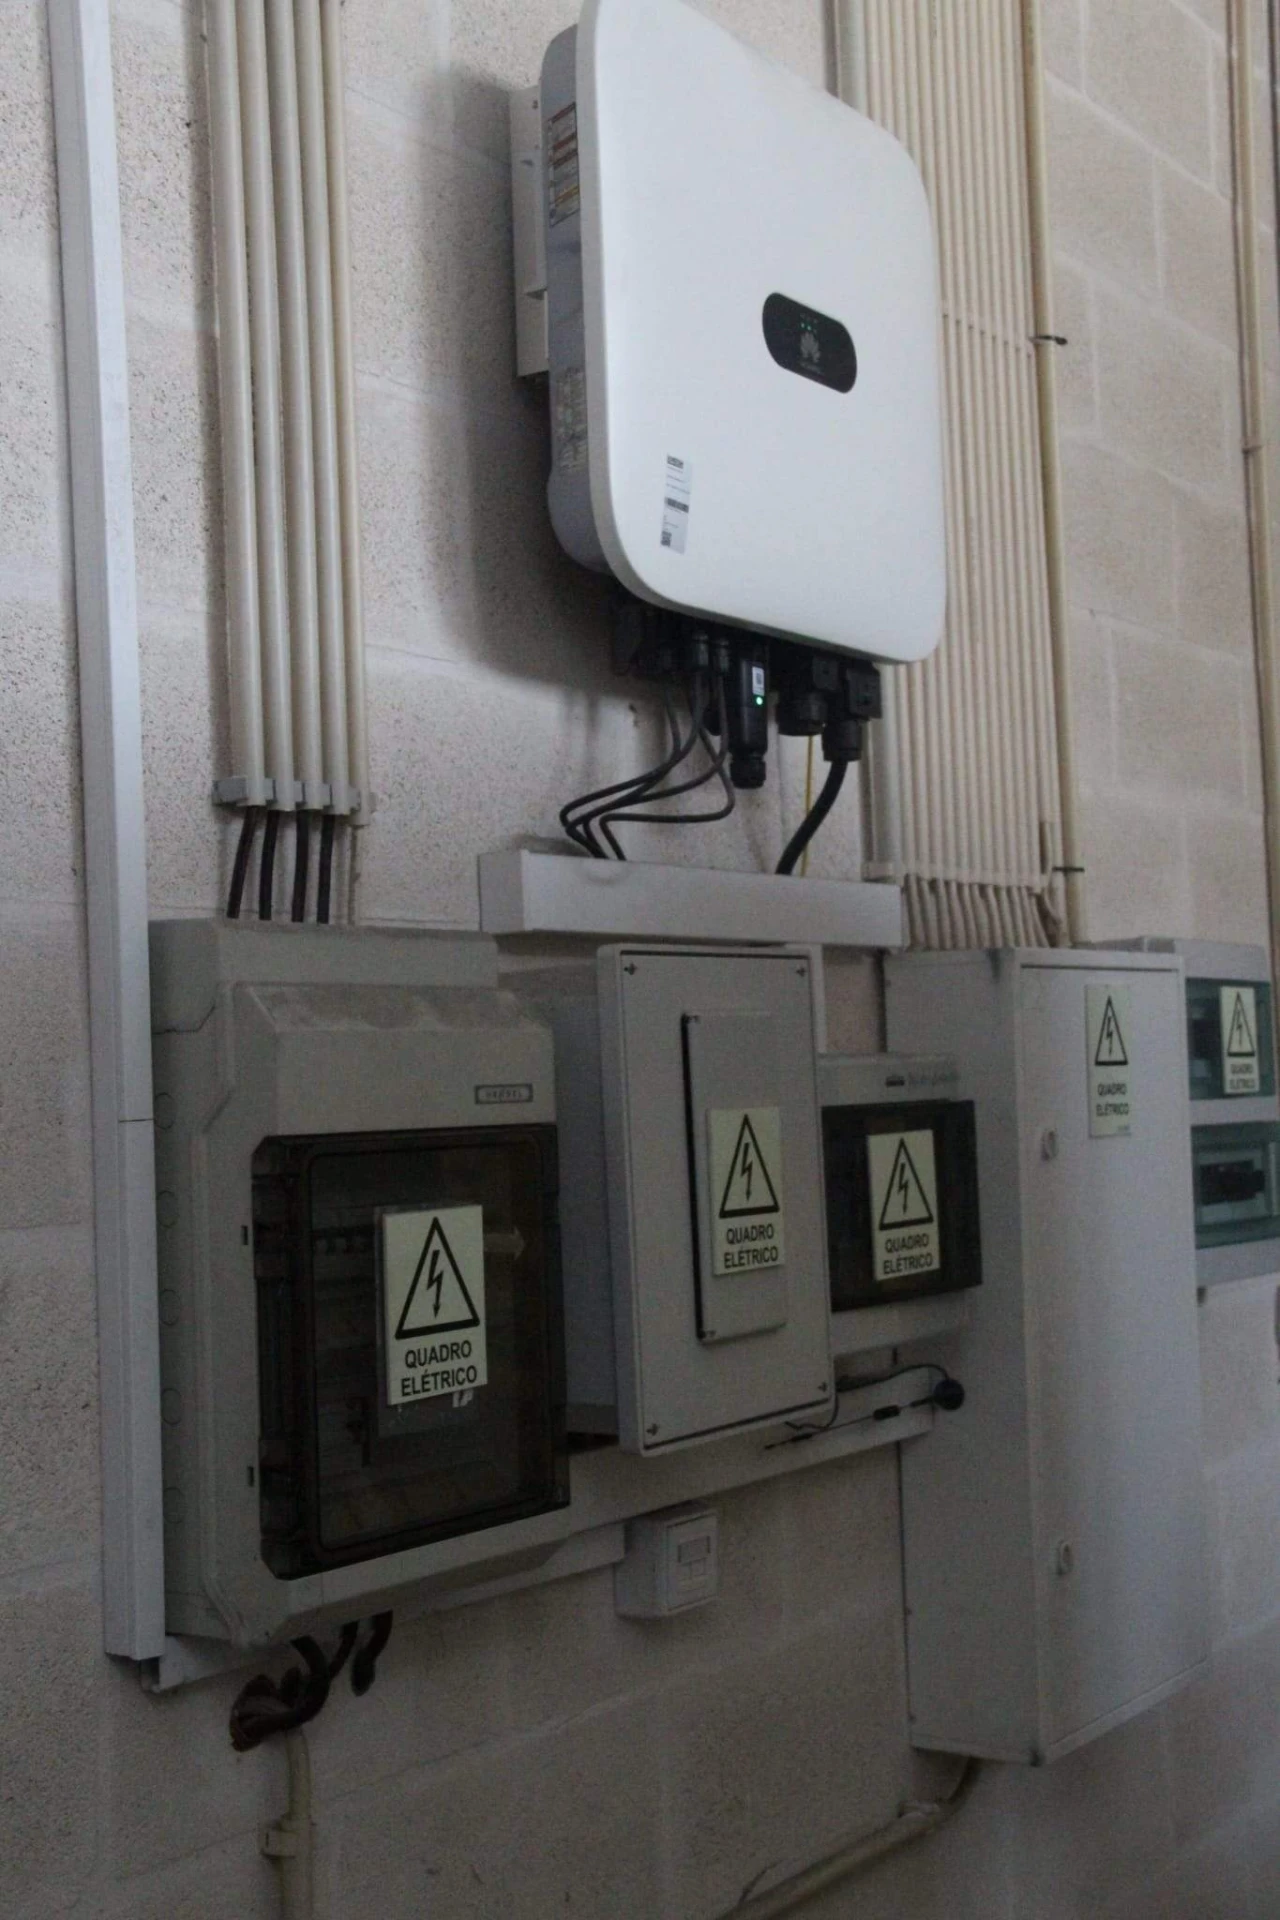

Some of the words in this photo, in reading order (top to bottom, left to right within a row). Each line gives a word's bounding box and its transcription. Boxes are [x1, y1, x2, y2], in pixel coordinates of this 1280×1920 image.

[726, 1223, 774, 1245] QUADRO
[885, 1233, 929, 1253] QUADRO
[724, 1245, 779, 1269] ELÉTRICO
[883, 1252, 933, 1275] ELÉTRICO
[405, 1340, 472, 1369] QUADRO
[401, 1365, 477, 1397] ELÉTRICO
